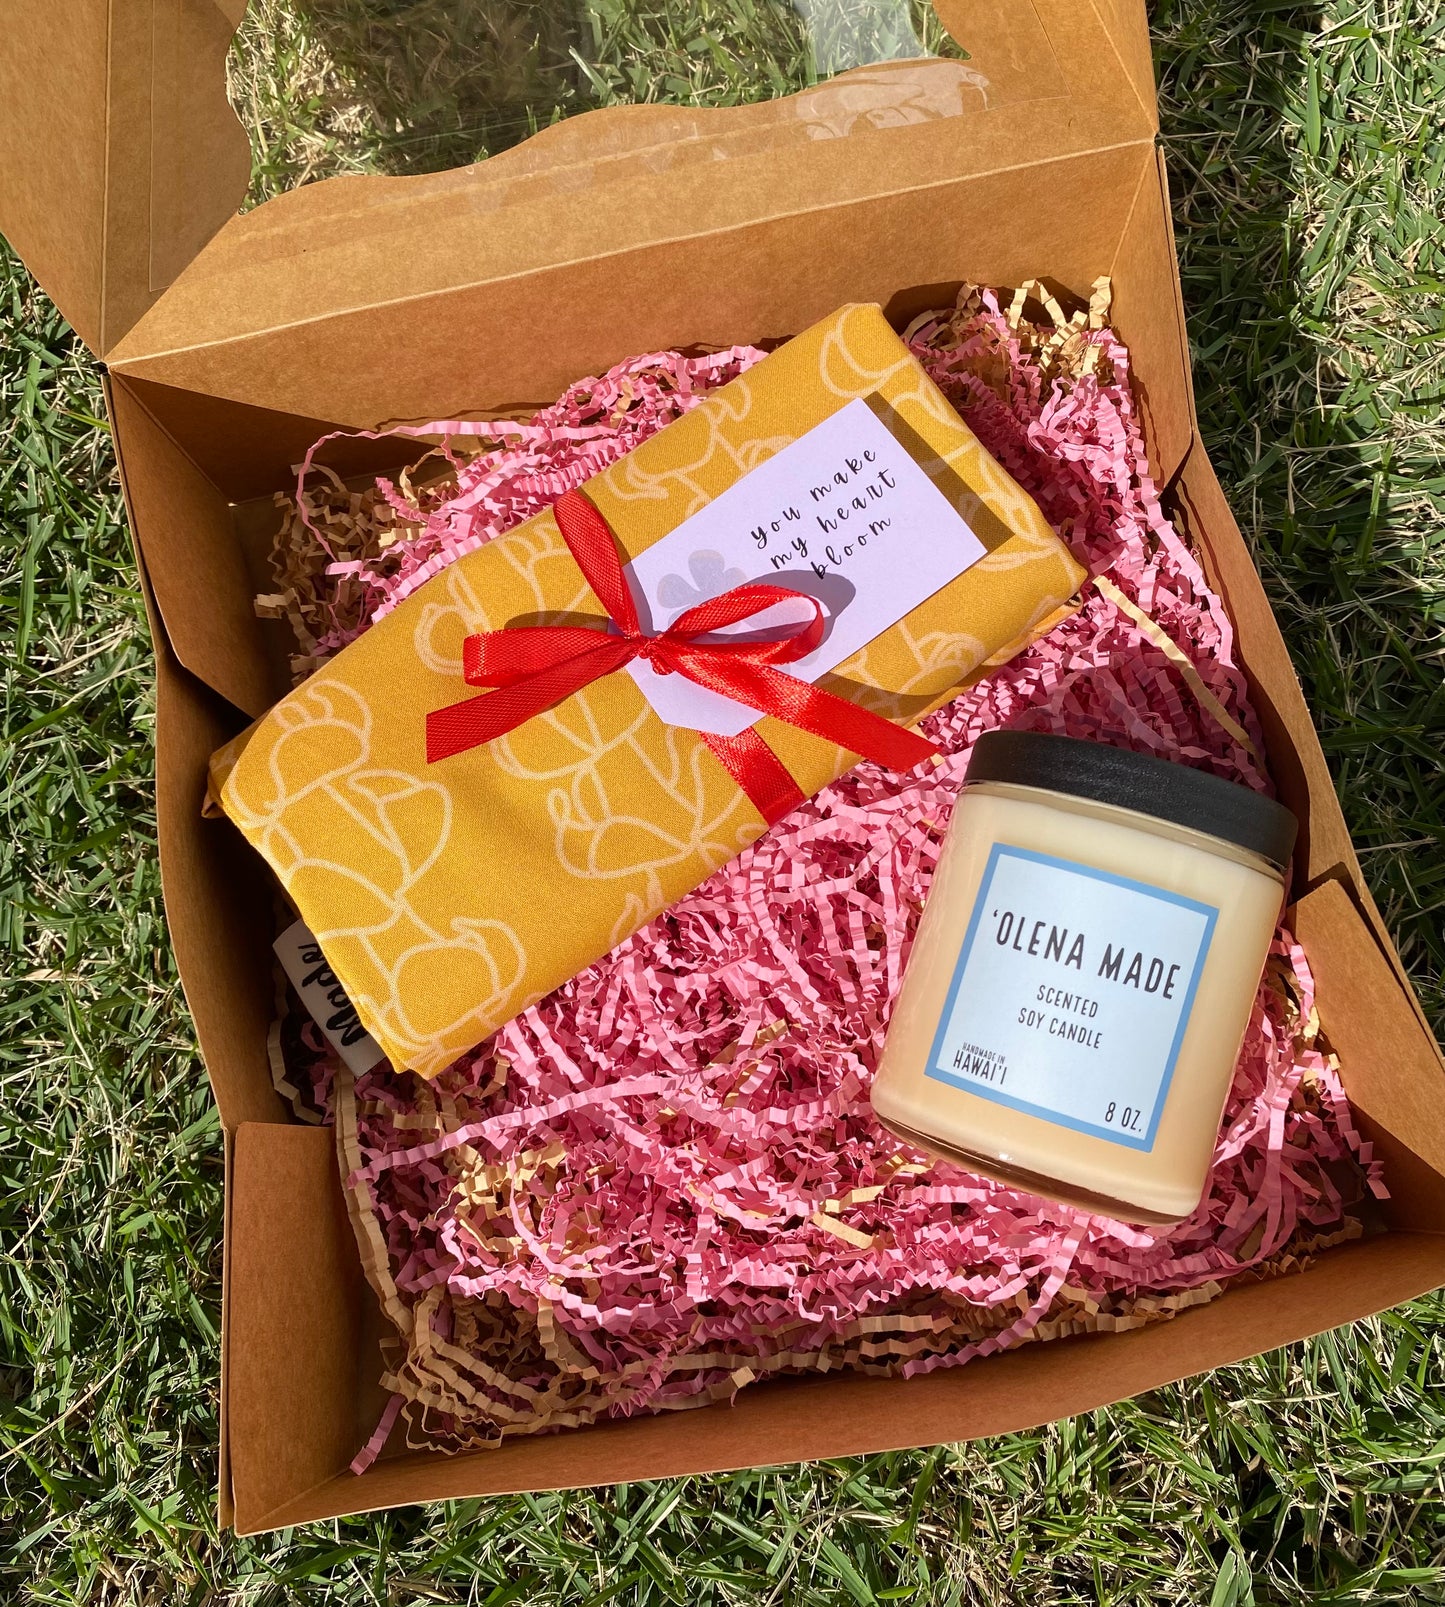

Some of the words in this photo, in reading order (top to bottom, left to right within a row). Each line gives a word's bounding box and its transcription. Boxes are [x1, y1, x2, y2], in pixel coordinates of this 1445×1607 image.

[751, 507, 801, 549] you
[810, 450, 876, 502] make
[770, 537, 808, 569] my
[816, 469, 896, 533] heart
[811, 518, 891, 580] bloom
[298, 943, 368, 1046] Made
[1097, 943, 1181, 999] MADE
[1018, 1008, 1045, 1029] SOY
[1049, 1018, 1102, 1049] CANDLE
[1036, 985, 1099, 1018] SCENTED
[962, 1042, 996, 1061] HANDMADE
[997, 1055, 1005, 1064] IN
[1104, 1102, 1116, 1122] 8
[1121, 1106, 1142, 1132] OZ.
